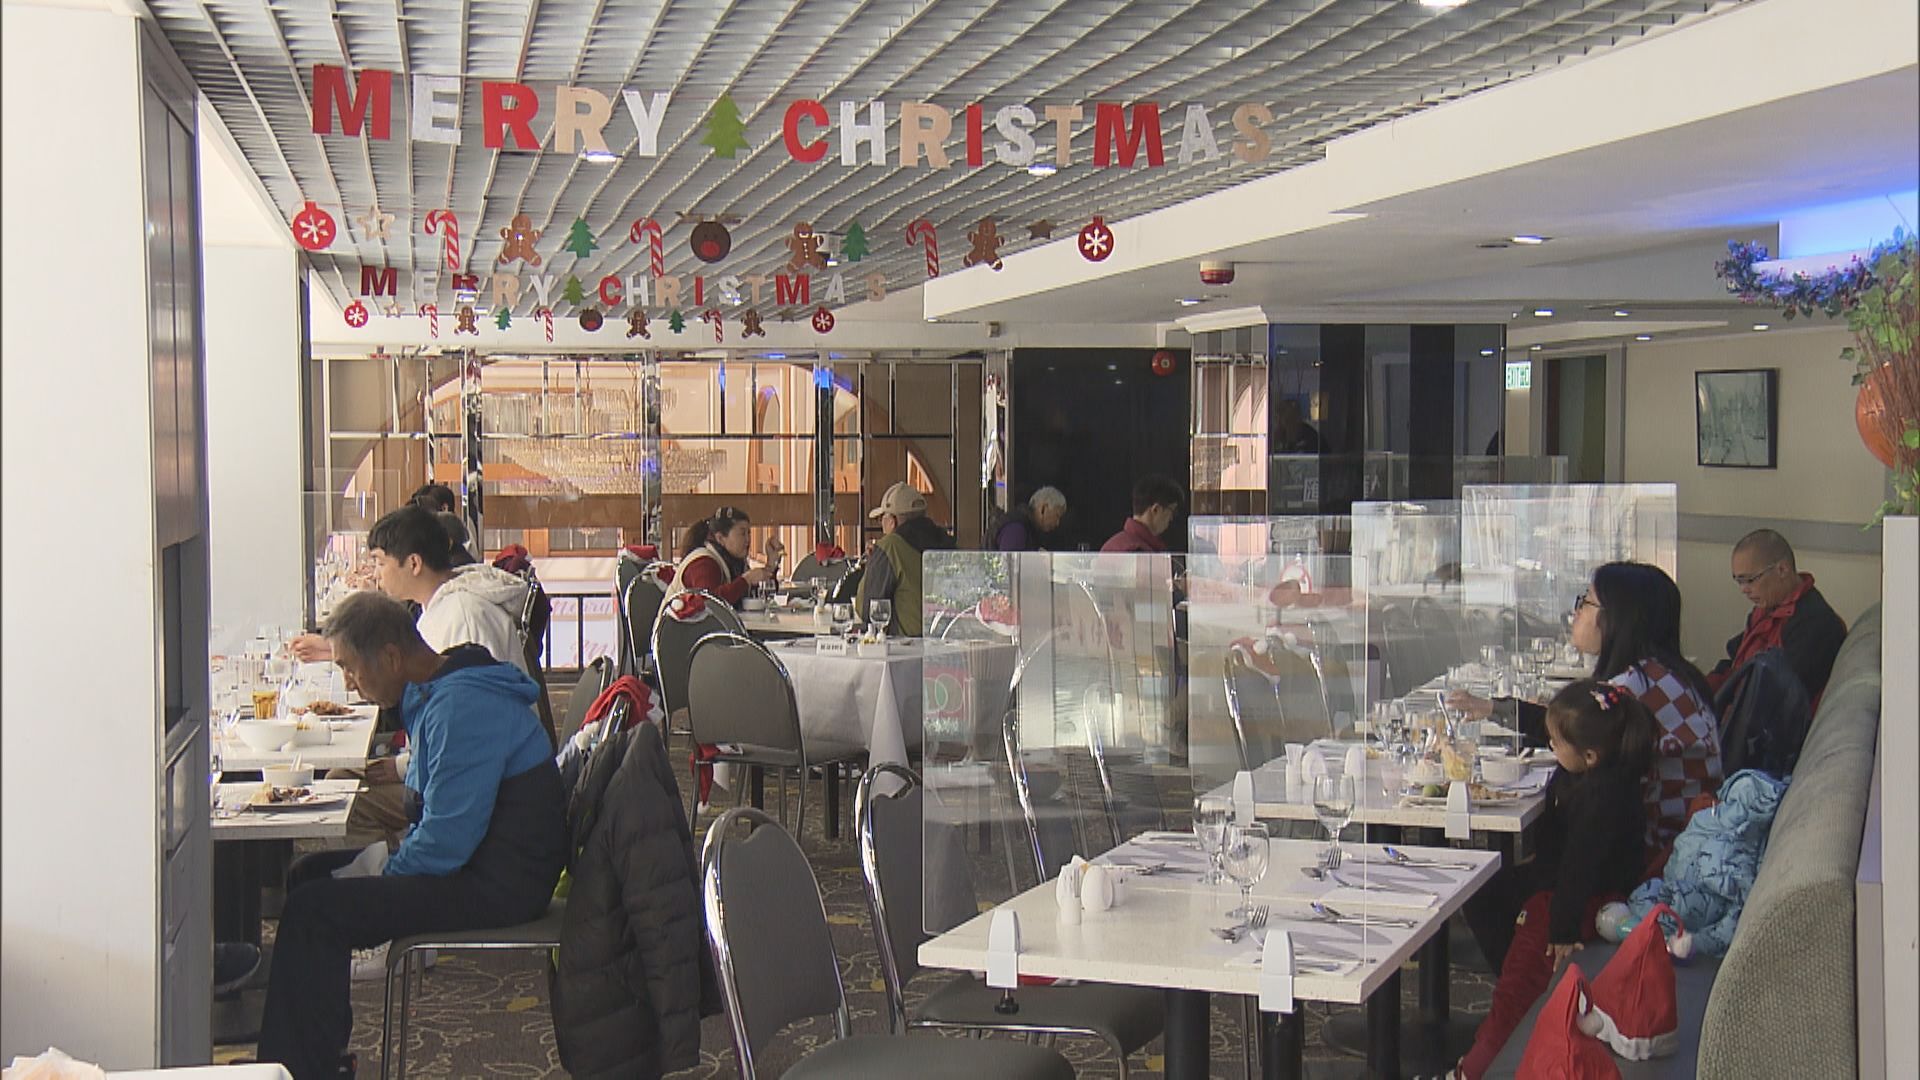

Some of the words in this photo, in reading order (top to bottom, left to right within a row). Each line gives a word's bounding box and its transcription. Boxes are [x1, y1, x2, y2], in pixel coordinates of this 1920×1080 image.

[311, 64, 672, 157] MERRY
[782, 99, 1273, 169] CHRISTMAS
[360, 265, 554, 306] MERRY
[599, 274, 887, 307] CHRISTMAS
